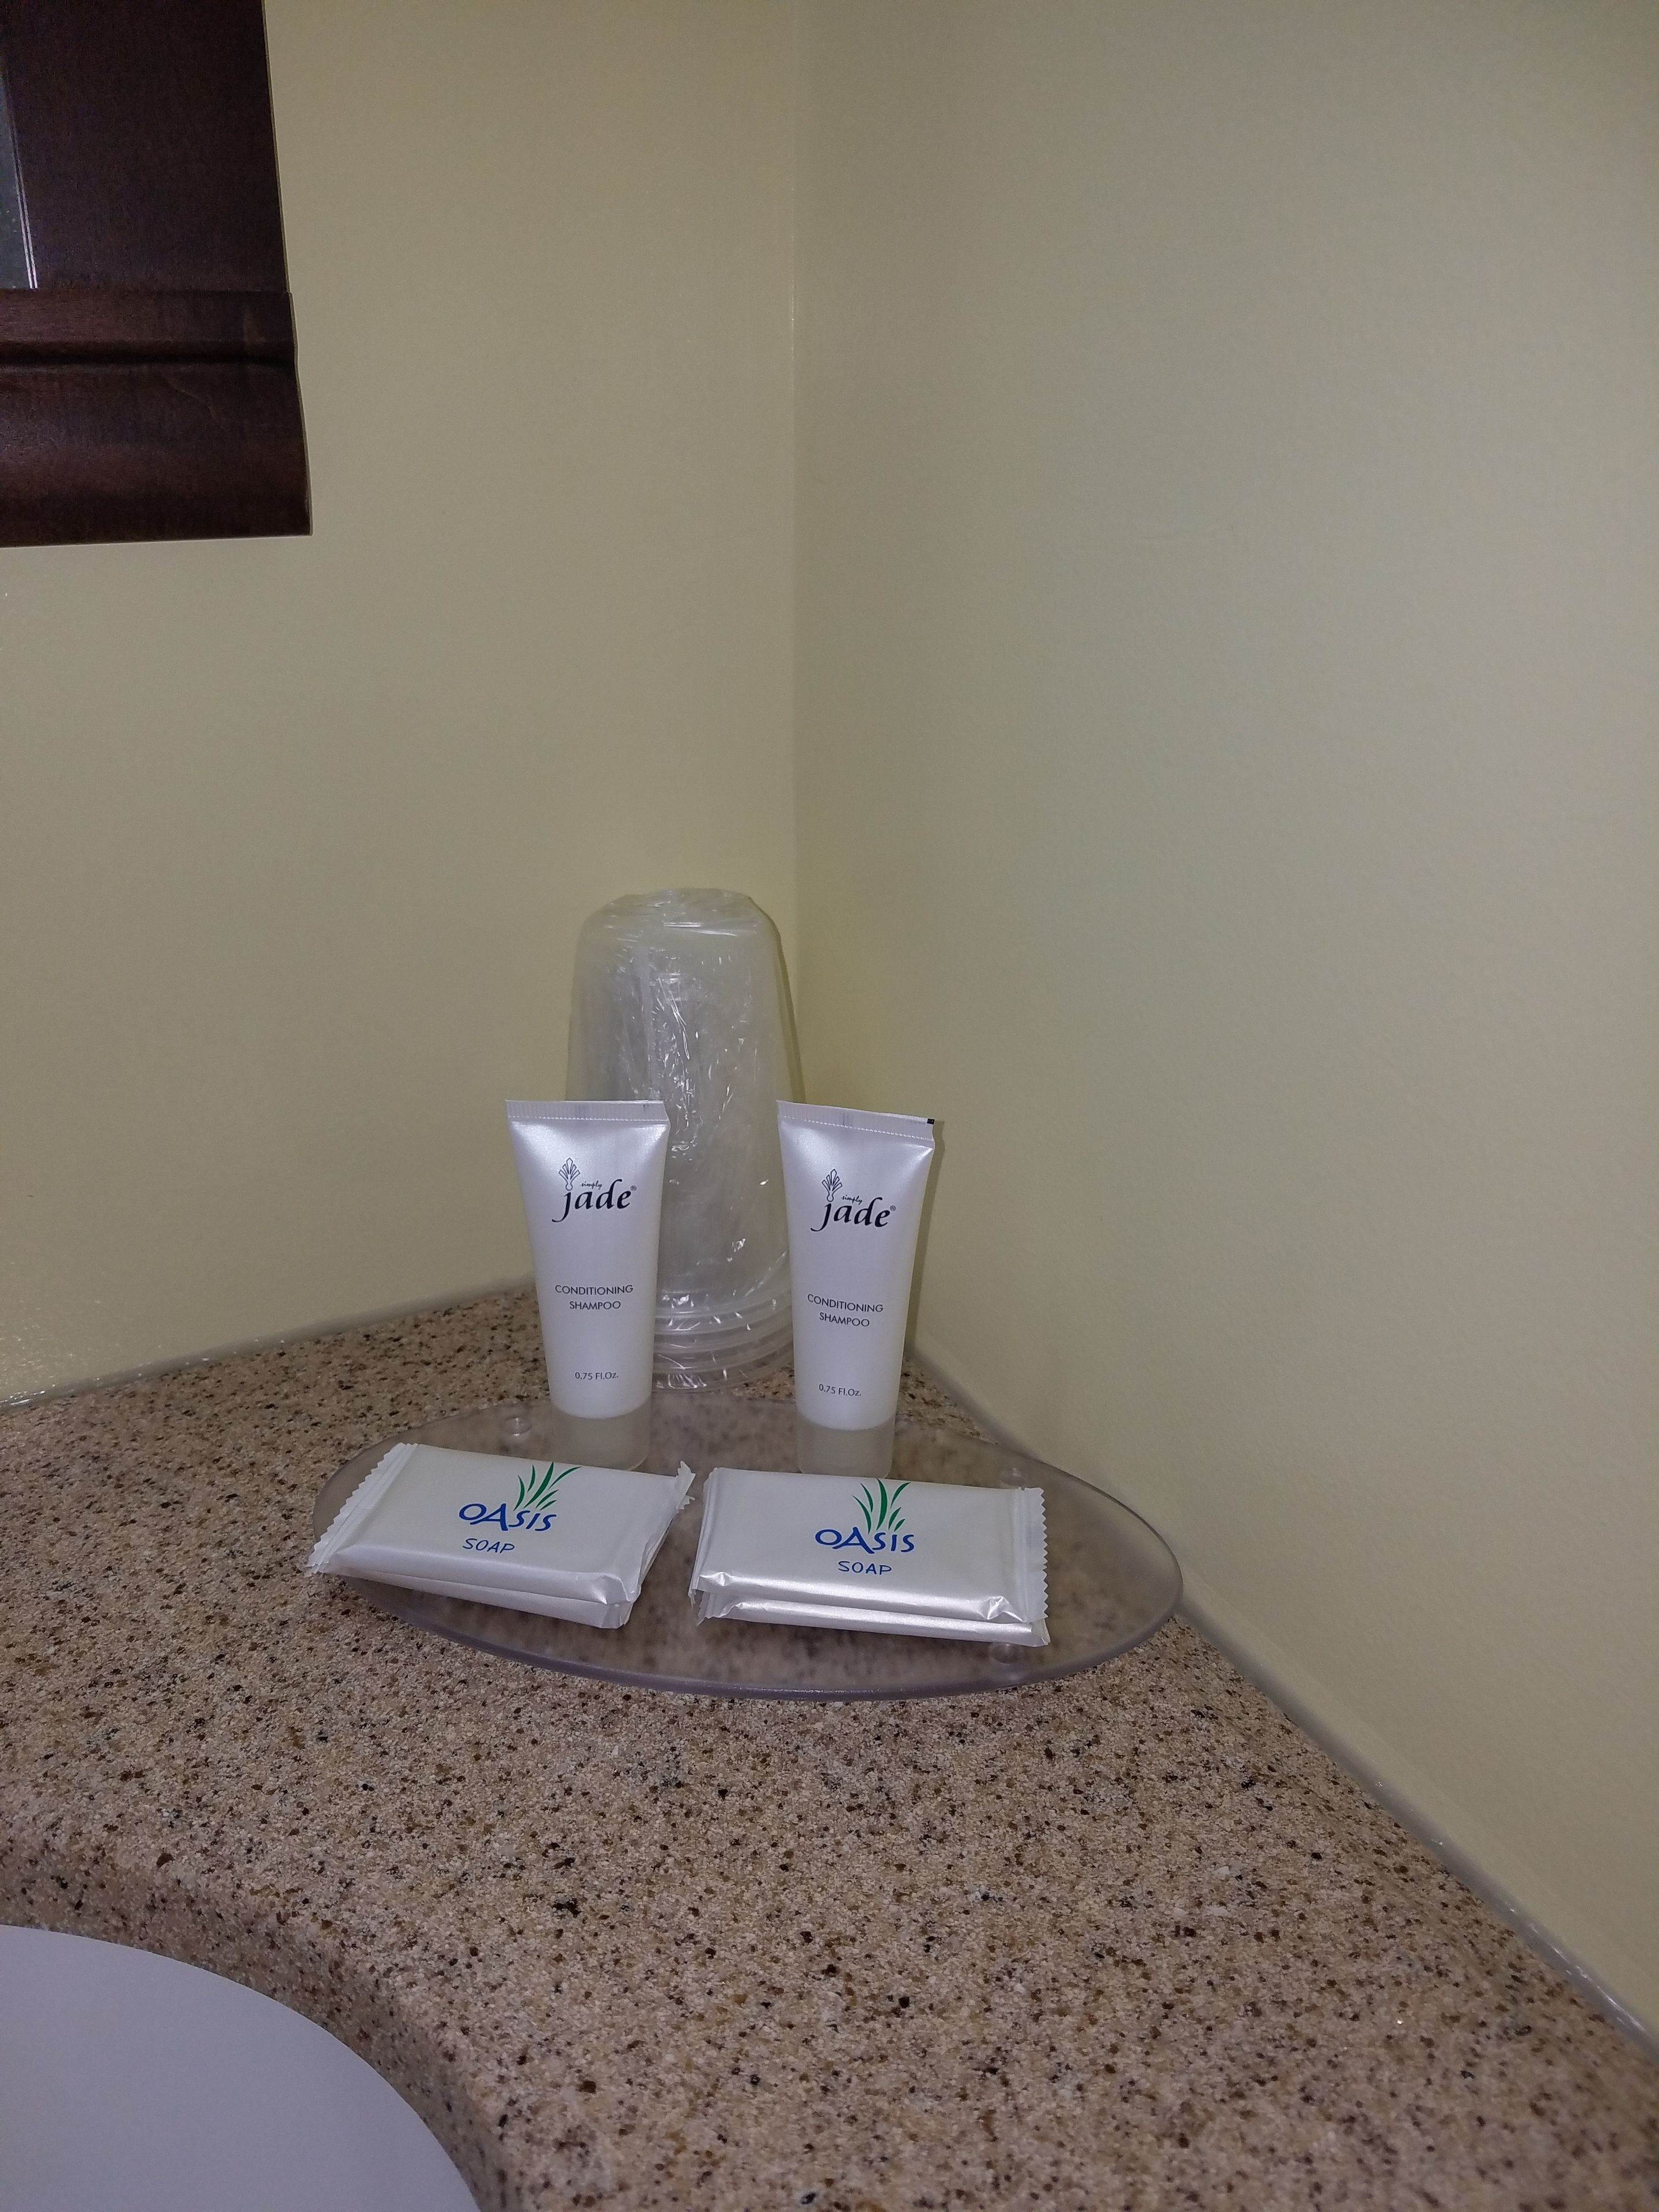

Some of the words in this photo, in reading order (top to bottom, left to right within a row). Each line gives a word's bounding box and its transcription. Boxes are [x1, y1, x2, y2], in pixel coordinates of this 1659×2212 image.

[581, 1180, 602, 1190] simply
[841, 1195, 863, 1205] simply
[555, 1285, 633, 1296] CONDITIONING
[570, 1301, 621, 1310] SHAMPOO
[808, 1294, 883, 1312] CONDITIONING
[819, 1312, 870, 1327] SHAMPOO
[575, 1372, 593, 1380] 0.75
[819, 1384, 836, 1394] 0.75
[459, 1503, 557, 1532] OASIS
[463, 1538, 515, 1554] SOAP
[815, 1527, 915, 1554] OASIS
[838, 1560, 892, 1575] SOAP
